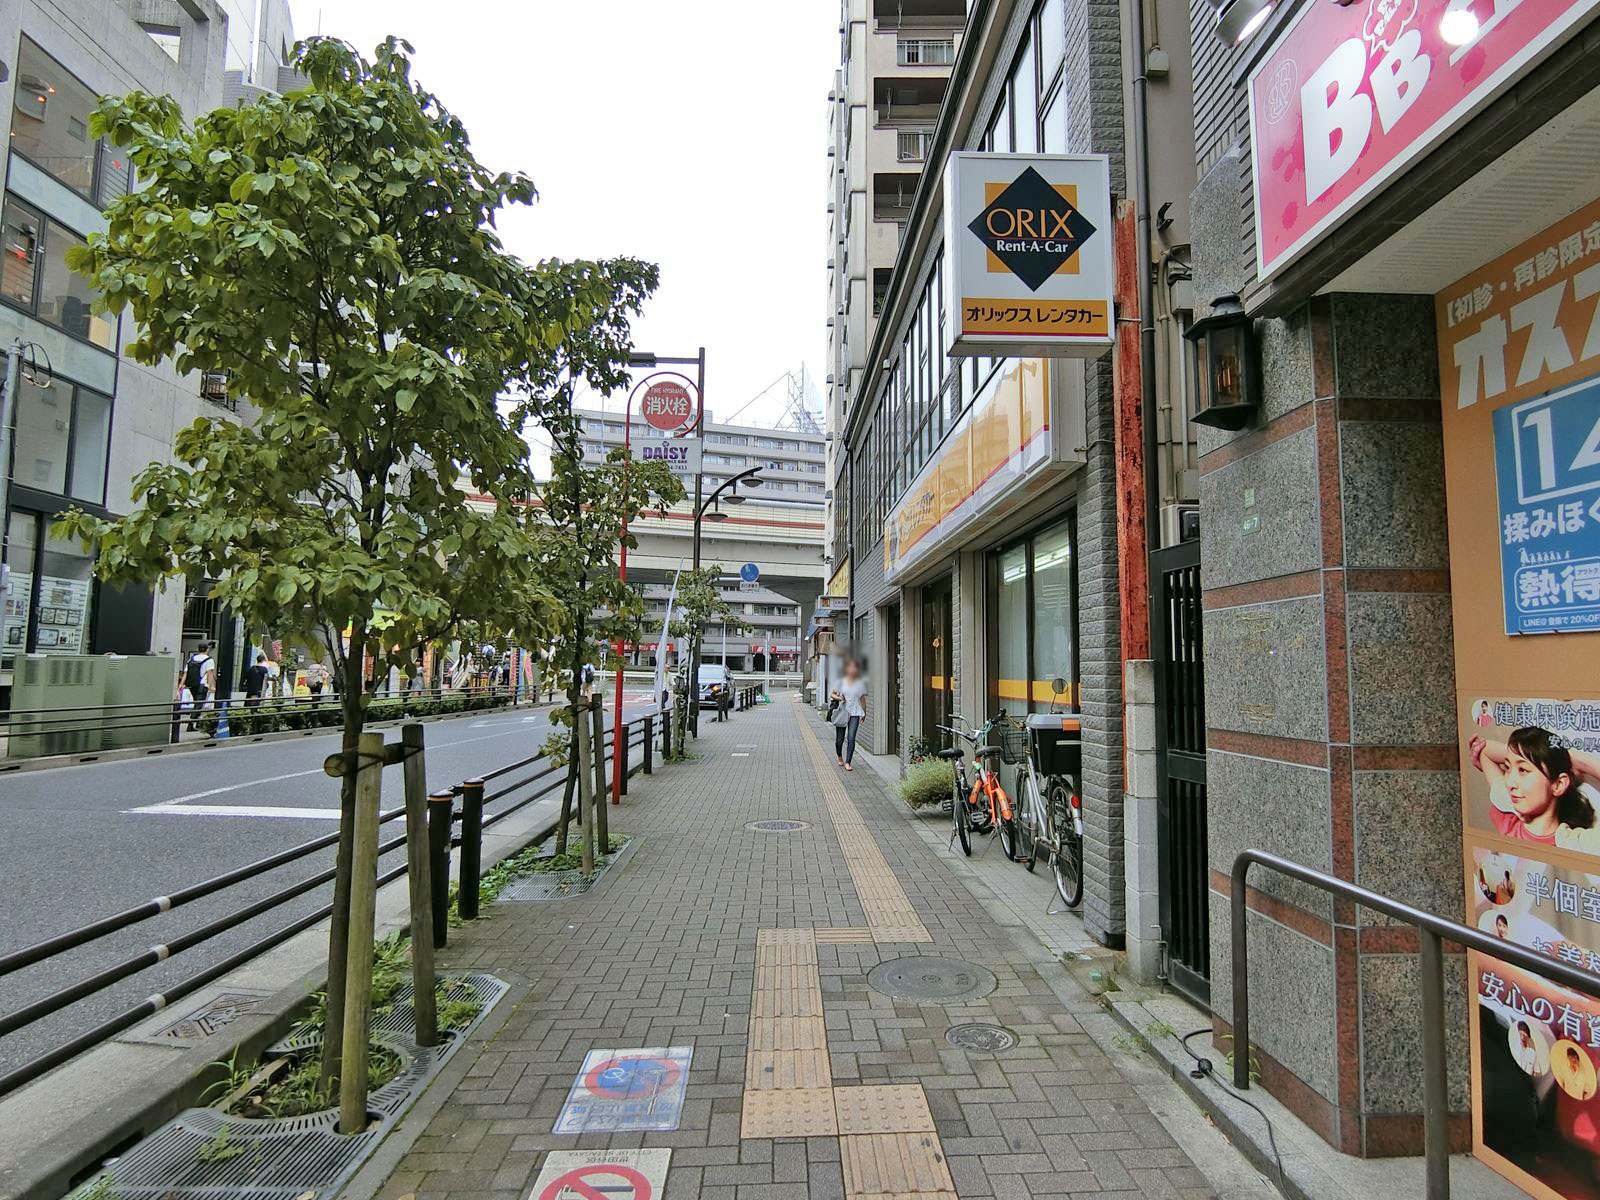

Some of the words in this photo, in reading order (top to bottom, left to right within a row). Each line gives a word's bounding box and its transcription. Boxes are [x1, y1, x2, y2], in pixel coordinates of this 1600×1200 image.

[986, 208, 1075, 239] ORIX
[996, 240, 1069, 253] Rent-A-Car
[966, 306, 1032, 323] オリックス
[1037, 308, 1104, 324] レンタカー
[646, 396, 689, 416] 消火栓
[642, 446, 689, 460] DAISY
[1519, 562, 1600, 608] 熱得
[1493, 701, 1600, 732] 健康保険施
